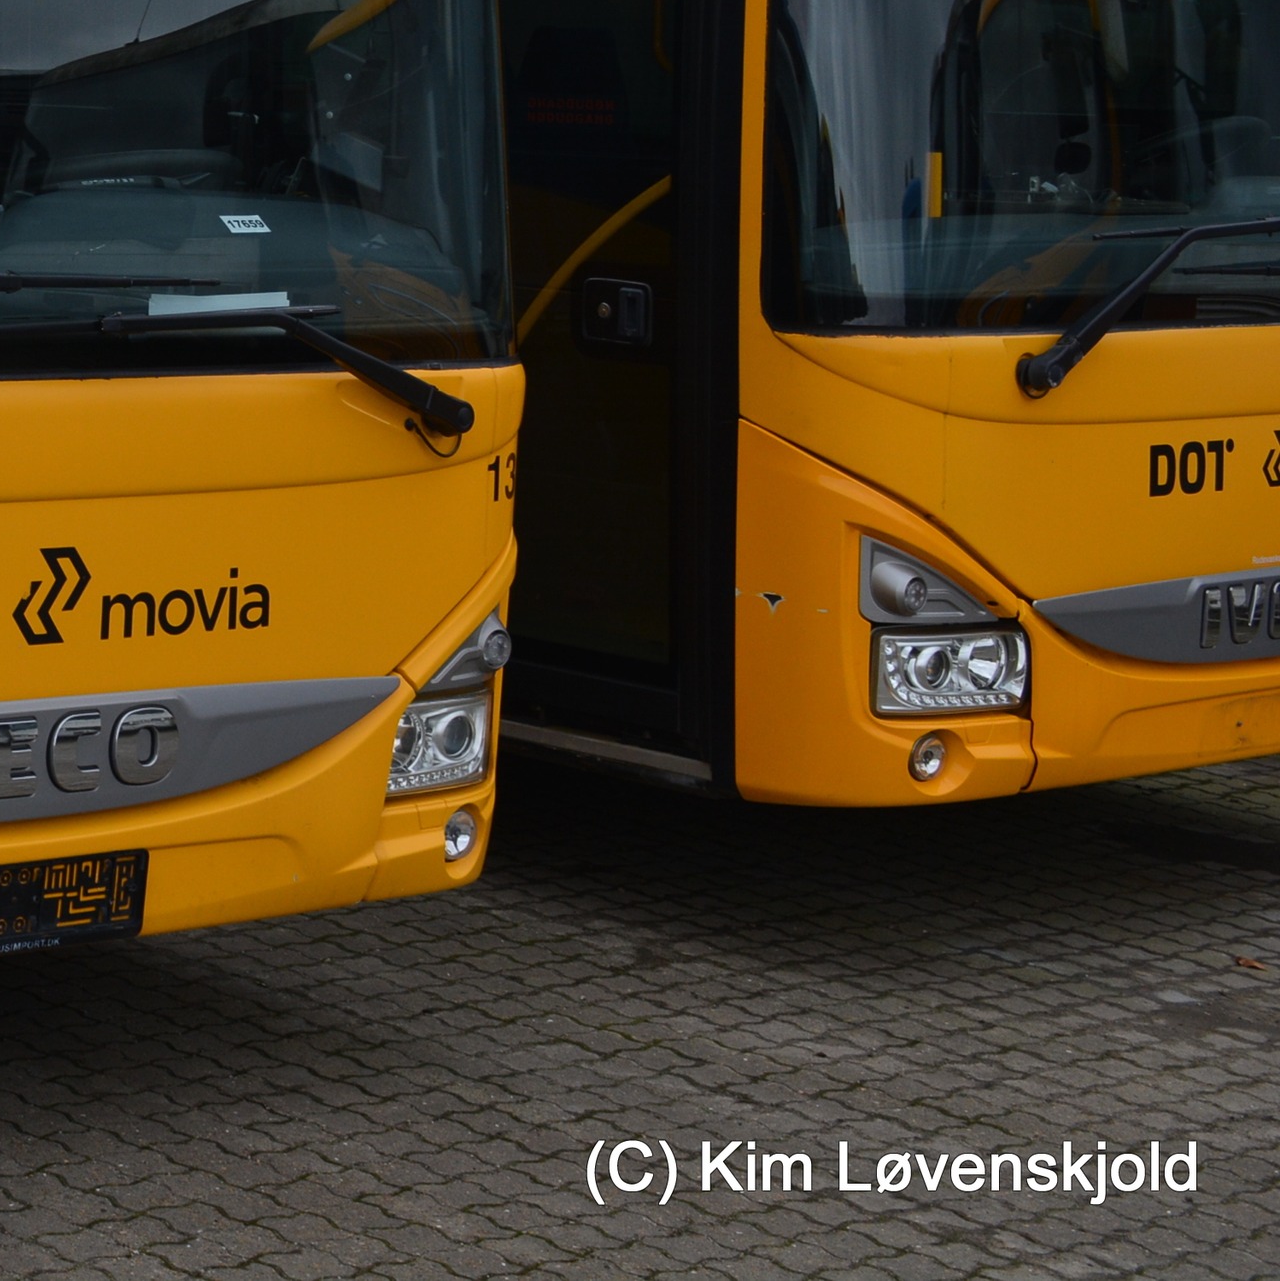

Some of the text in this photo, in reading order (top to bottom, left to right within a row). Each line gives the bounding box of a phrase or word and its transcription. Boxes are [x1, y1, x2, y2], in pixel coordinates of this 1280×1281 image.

[227, 219, 265, 229] 17659
[1149, 438, 1235, 498] DOT
[100, 567, 270, 640] movia
